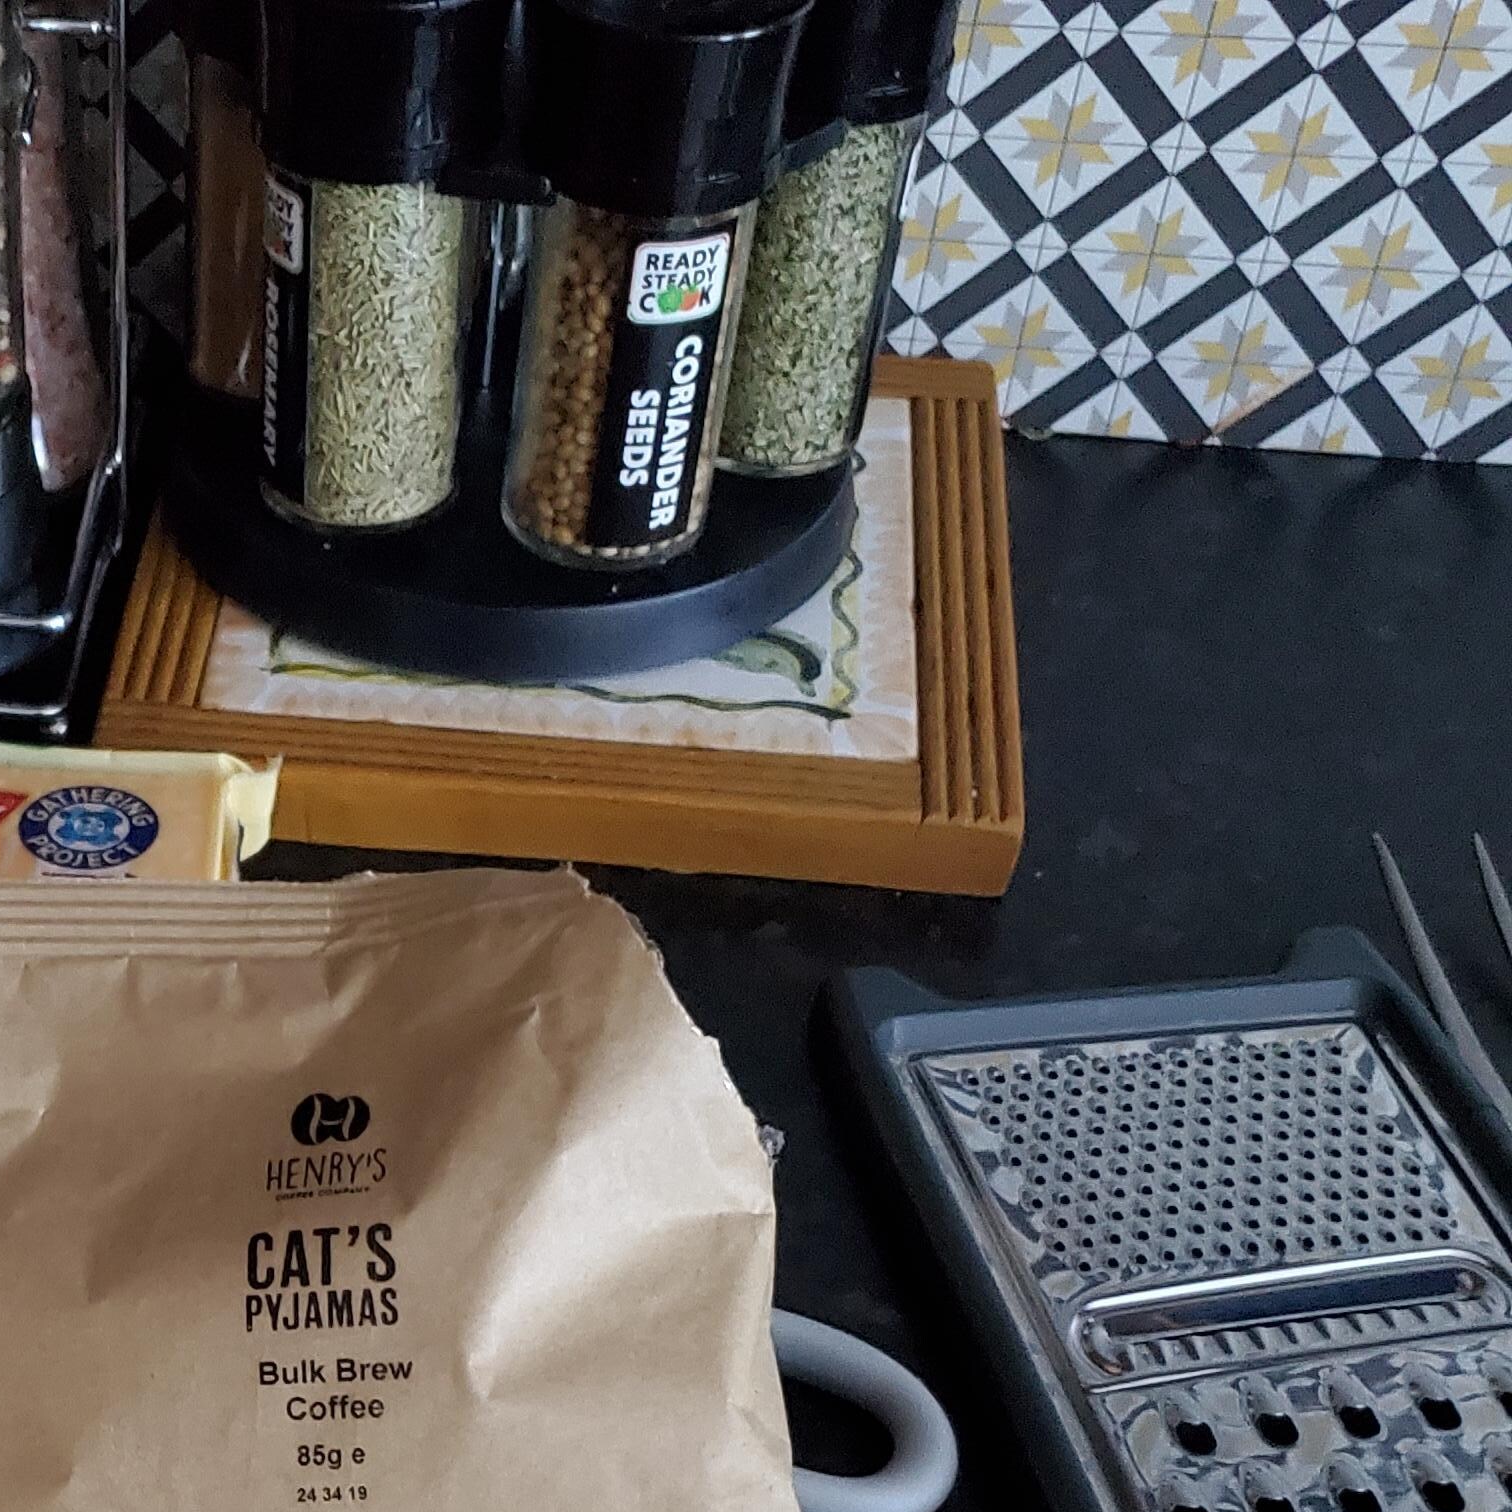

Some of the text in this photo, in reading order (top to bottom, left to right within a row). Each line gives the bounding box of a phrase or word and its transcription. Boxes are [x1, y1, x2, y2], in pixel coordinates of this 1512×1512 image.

[645, 244, 721, 272] READY
[641, 264, 718, 290] STEADY
[619, 389, 661, 488] SEEDS
[648, 334, 703, 530] CORIANDER
[26, 788, 156, 827] GATHERING
[27, 834, 138, 868] PROJECT
[265, 1147, 388, 1192] HENRY'S
[246, 1222, 397, 1290] CAT'S
[245, 1287, 399, 1333] PYJAMAS
[259, 1358, 413, 1386] Bulk Brew
[286, 1395, 385, 1421] Coffee
[297, 1444, 342, 1470] 85g
[297, 1485, 368, 1503] 24 34 19
